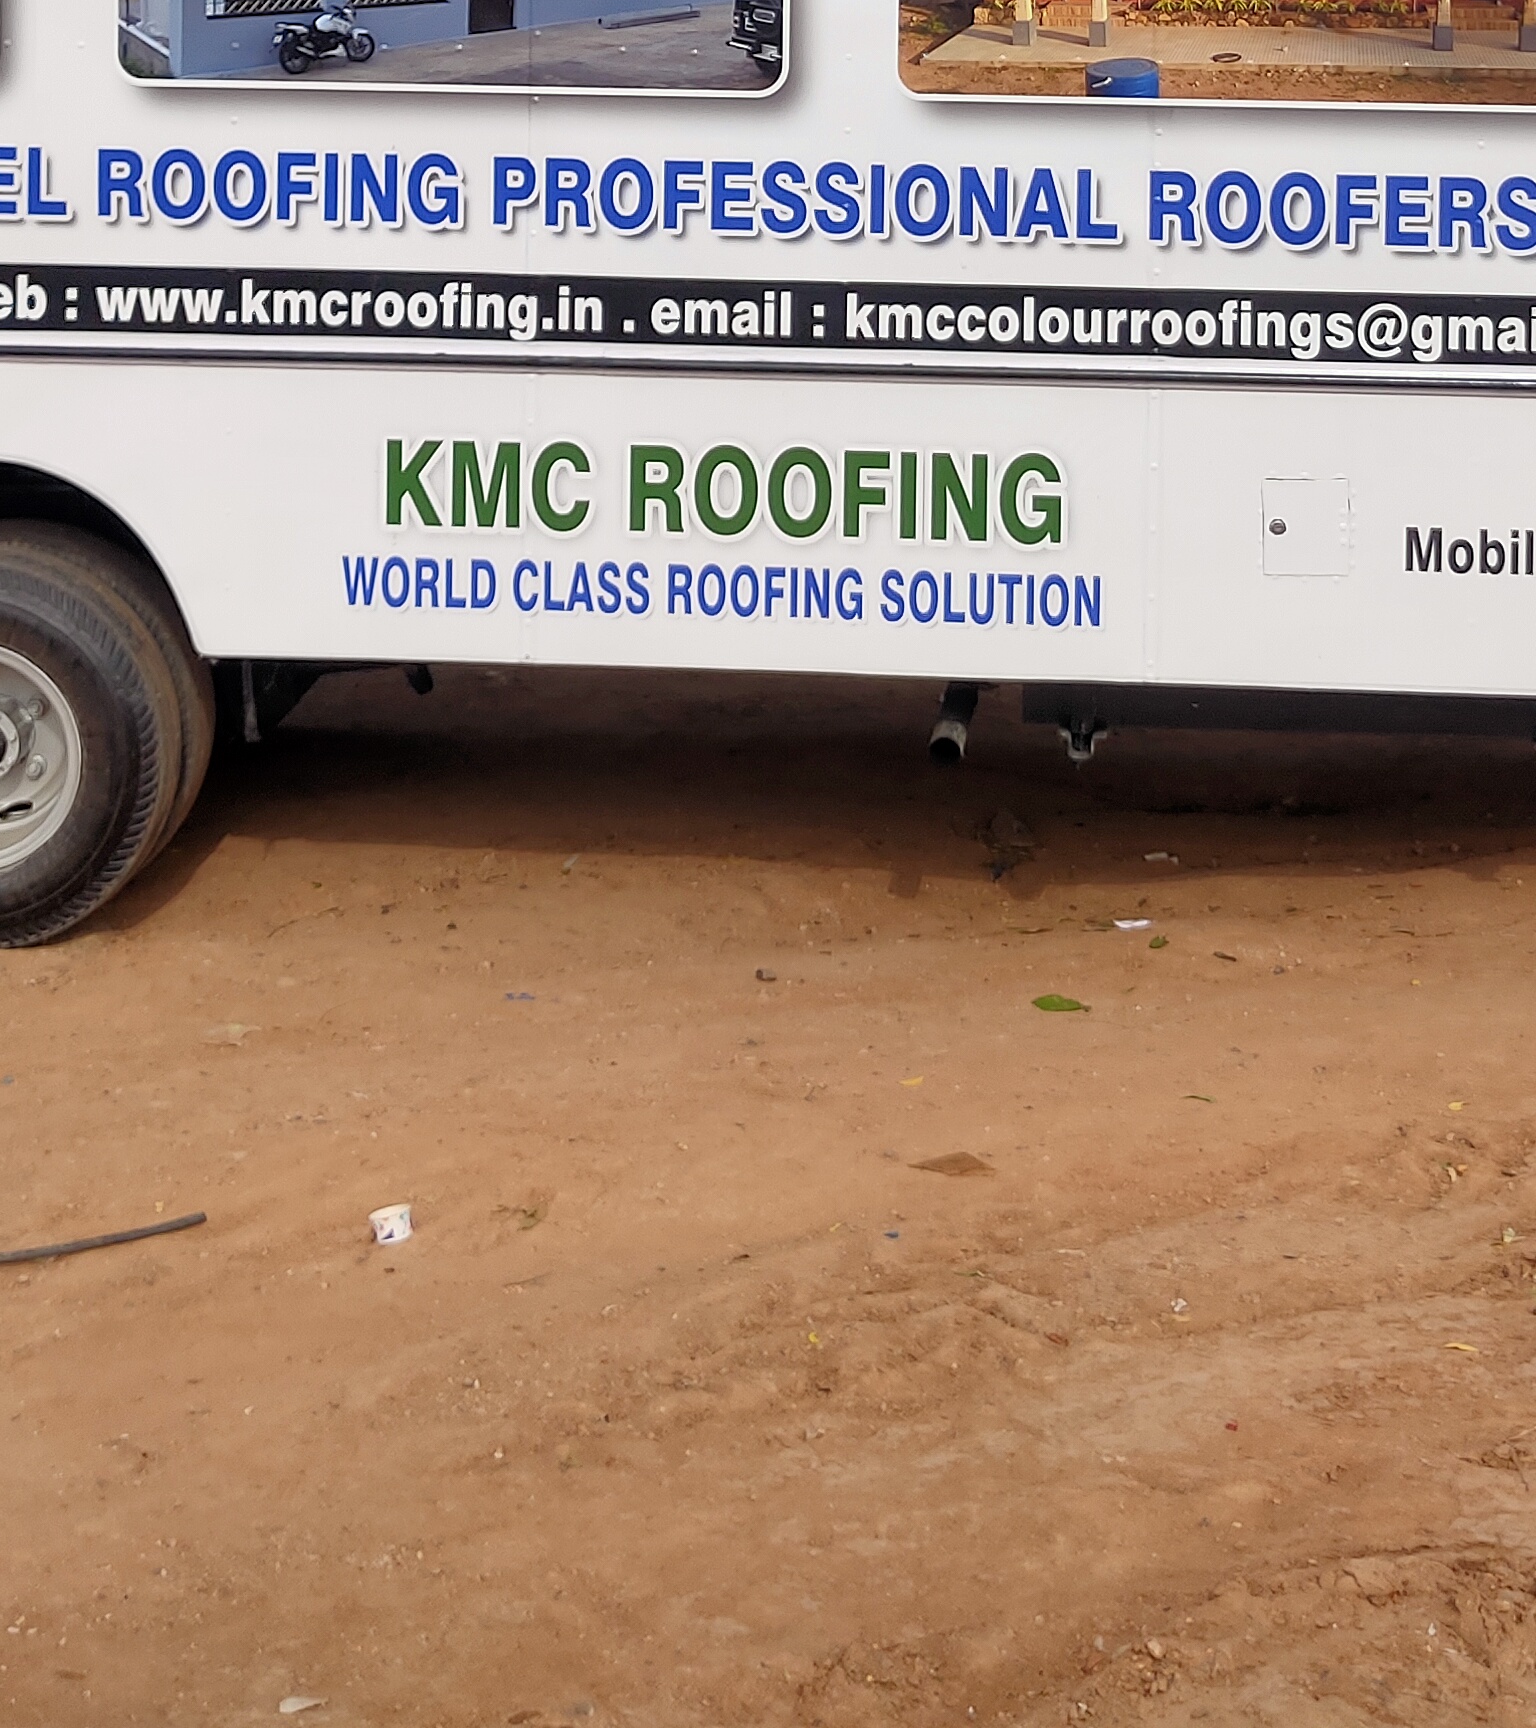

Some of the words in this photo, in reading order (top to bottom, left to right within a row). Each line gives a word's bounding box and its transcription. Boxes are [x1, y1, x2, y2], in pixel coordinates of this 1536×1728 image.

[97, 148, 459, 227] ROOFING
[492, 156, 1118, 242] PROFESSIONAL
[97, 274, 603, 341] www.kmcroofing.in
[650, 290, 792, 338] email
[386, 439, 592, 532] KMC
[629, 445, 1063, 545] ROOFING
[343, 556, 497, 610] WORLD
[513, 559, 651, 615] CLASS
[667, 564, 864, 622] ROOFING
[881, 569, 1102, 628] SOLUTION
